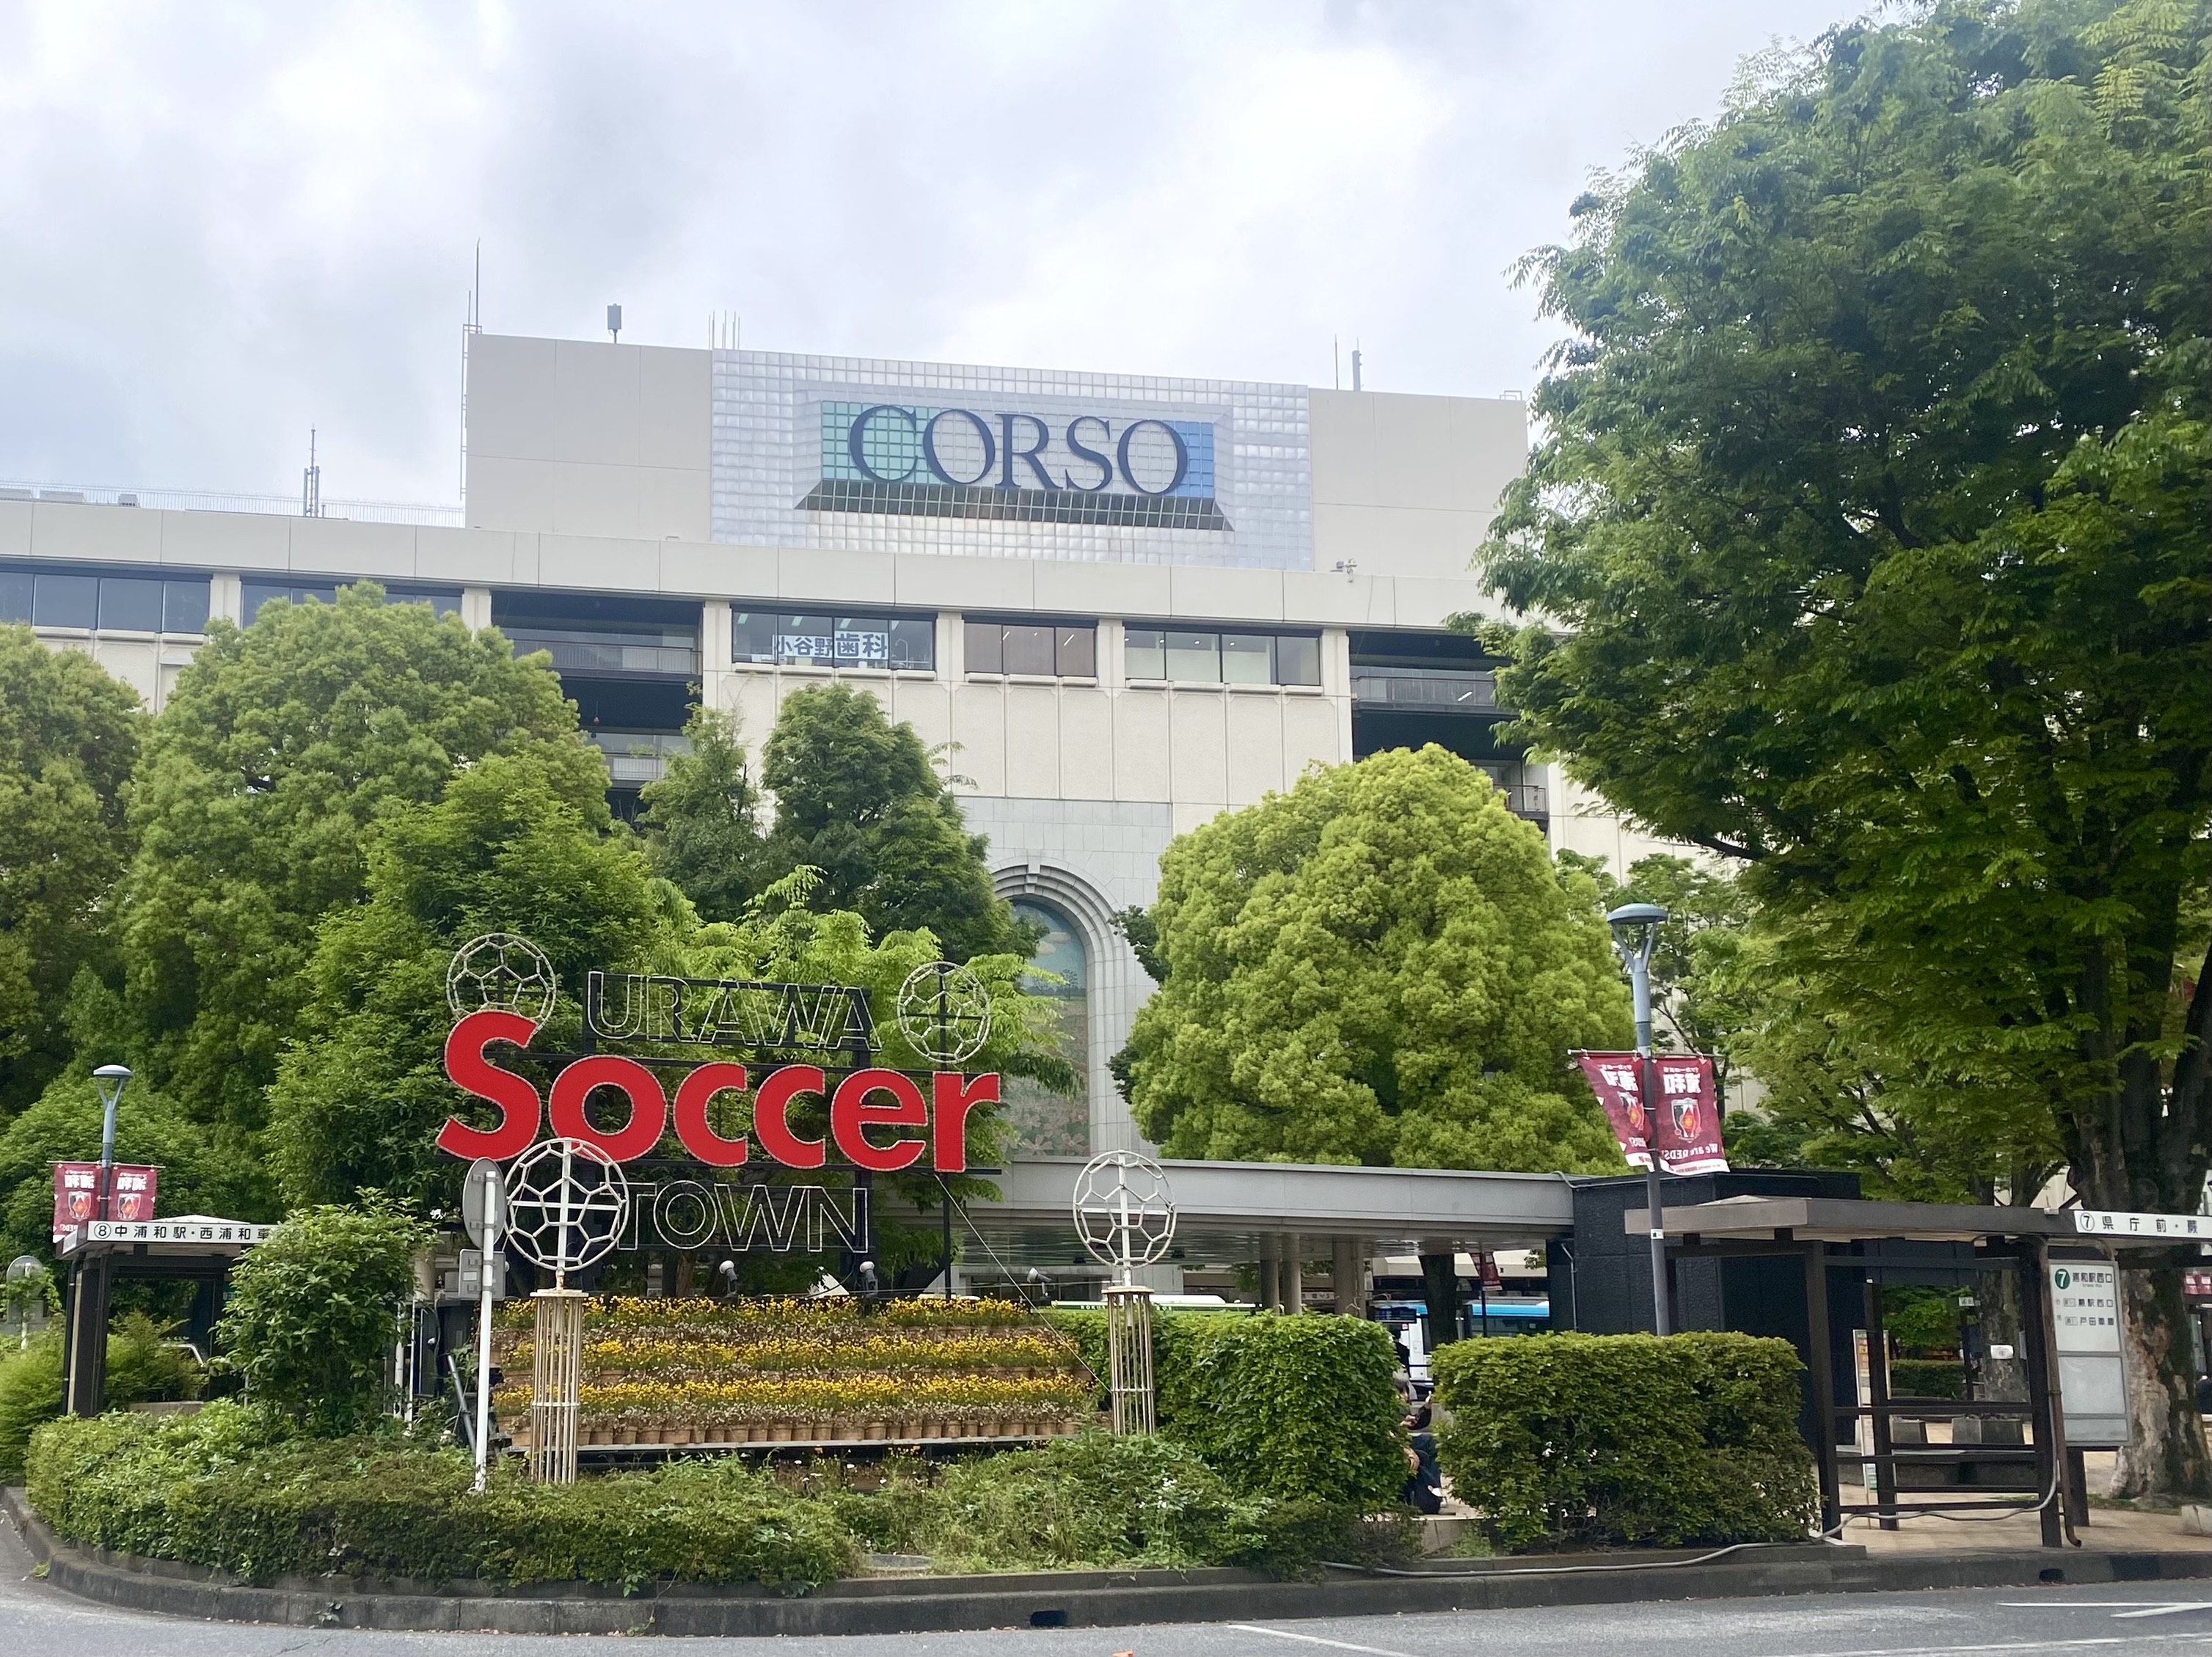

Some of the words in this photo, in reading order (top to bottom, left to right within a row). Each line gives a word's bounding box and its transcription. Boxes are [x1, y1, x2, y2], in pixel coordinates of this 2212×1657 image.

[849, 404, 1189, 495] CORSO
[778, 633, 888, 658] 小谷野歯科
[588, 971, 882, 1052] URAWA
[436, 1010, 1001, 1173] Soccer
[600, 1179, 869, 1253] TOWN
